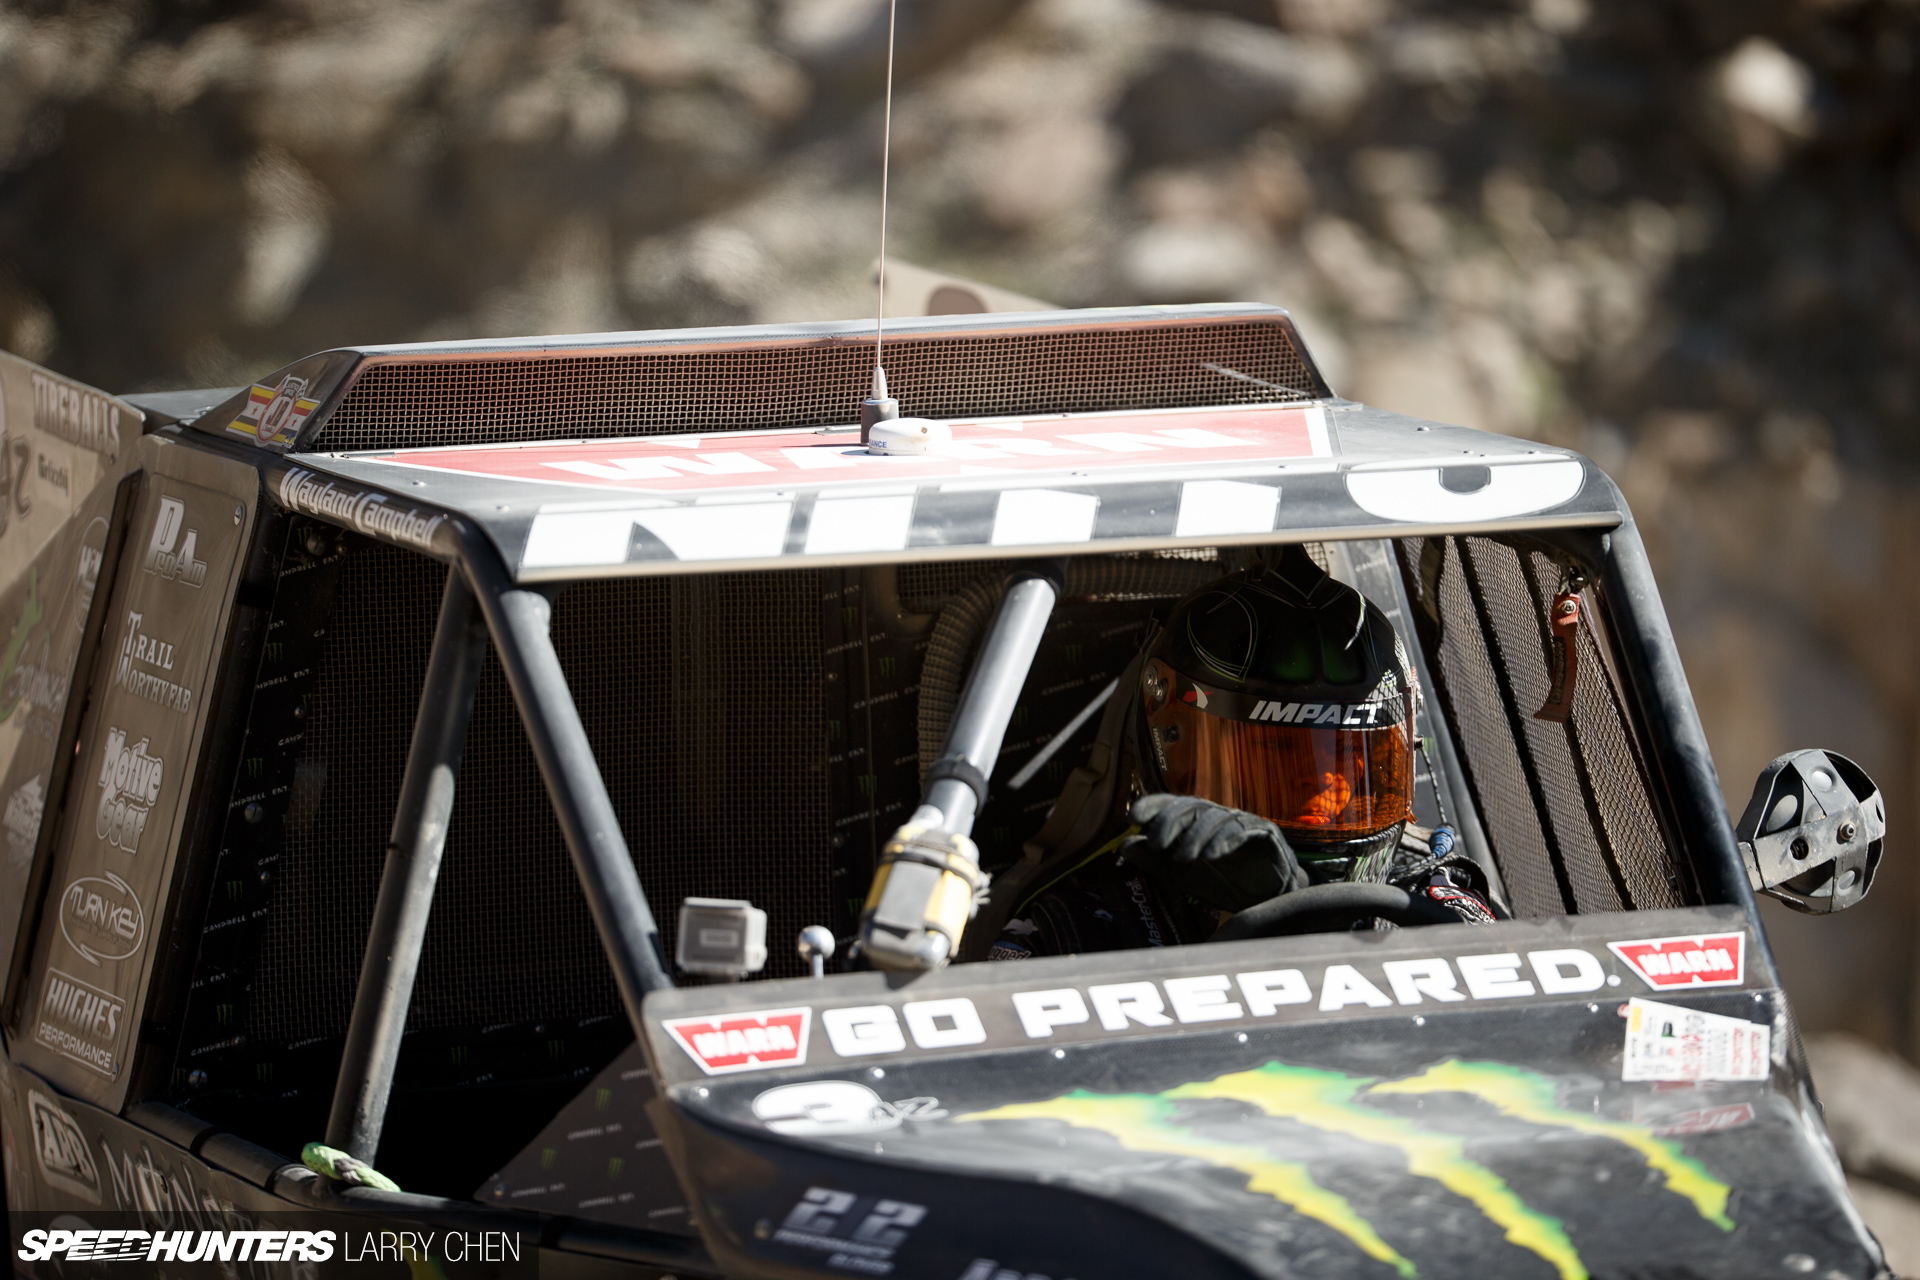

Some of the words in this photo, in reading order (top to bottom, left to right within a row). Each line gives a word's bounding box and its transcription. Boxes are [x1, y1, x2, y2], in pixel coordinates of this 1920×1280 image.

[280, 467, 365, 520] Wayland
[355, 492, 443, 548] Campbell
[280, 561, 317, 578] AMPBELL
[127, 610, 174, 671] TRAIL
[827, 640, 863, 655] AMPBELL
[1249, 700, 1382, 725] IMPACT
[98, 726, 164, 806] Motive
[1152, 727, 1168, 772] IMPACT
[96, 782, 149, 854] Gear
[43, 978, 121, 1042] HUGHES
[692, 1024, 797, 1059] WARN
[821, 996, 988, 1058] GO
[1637, 948, 1735, 976] WARN
[39, 1022, 112, 1069] PERFORMANCE
[38, 1107, 95, 1184] ARB
